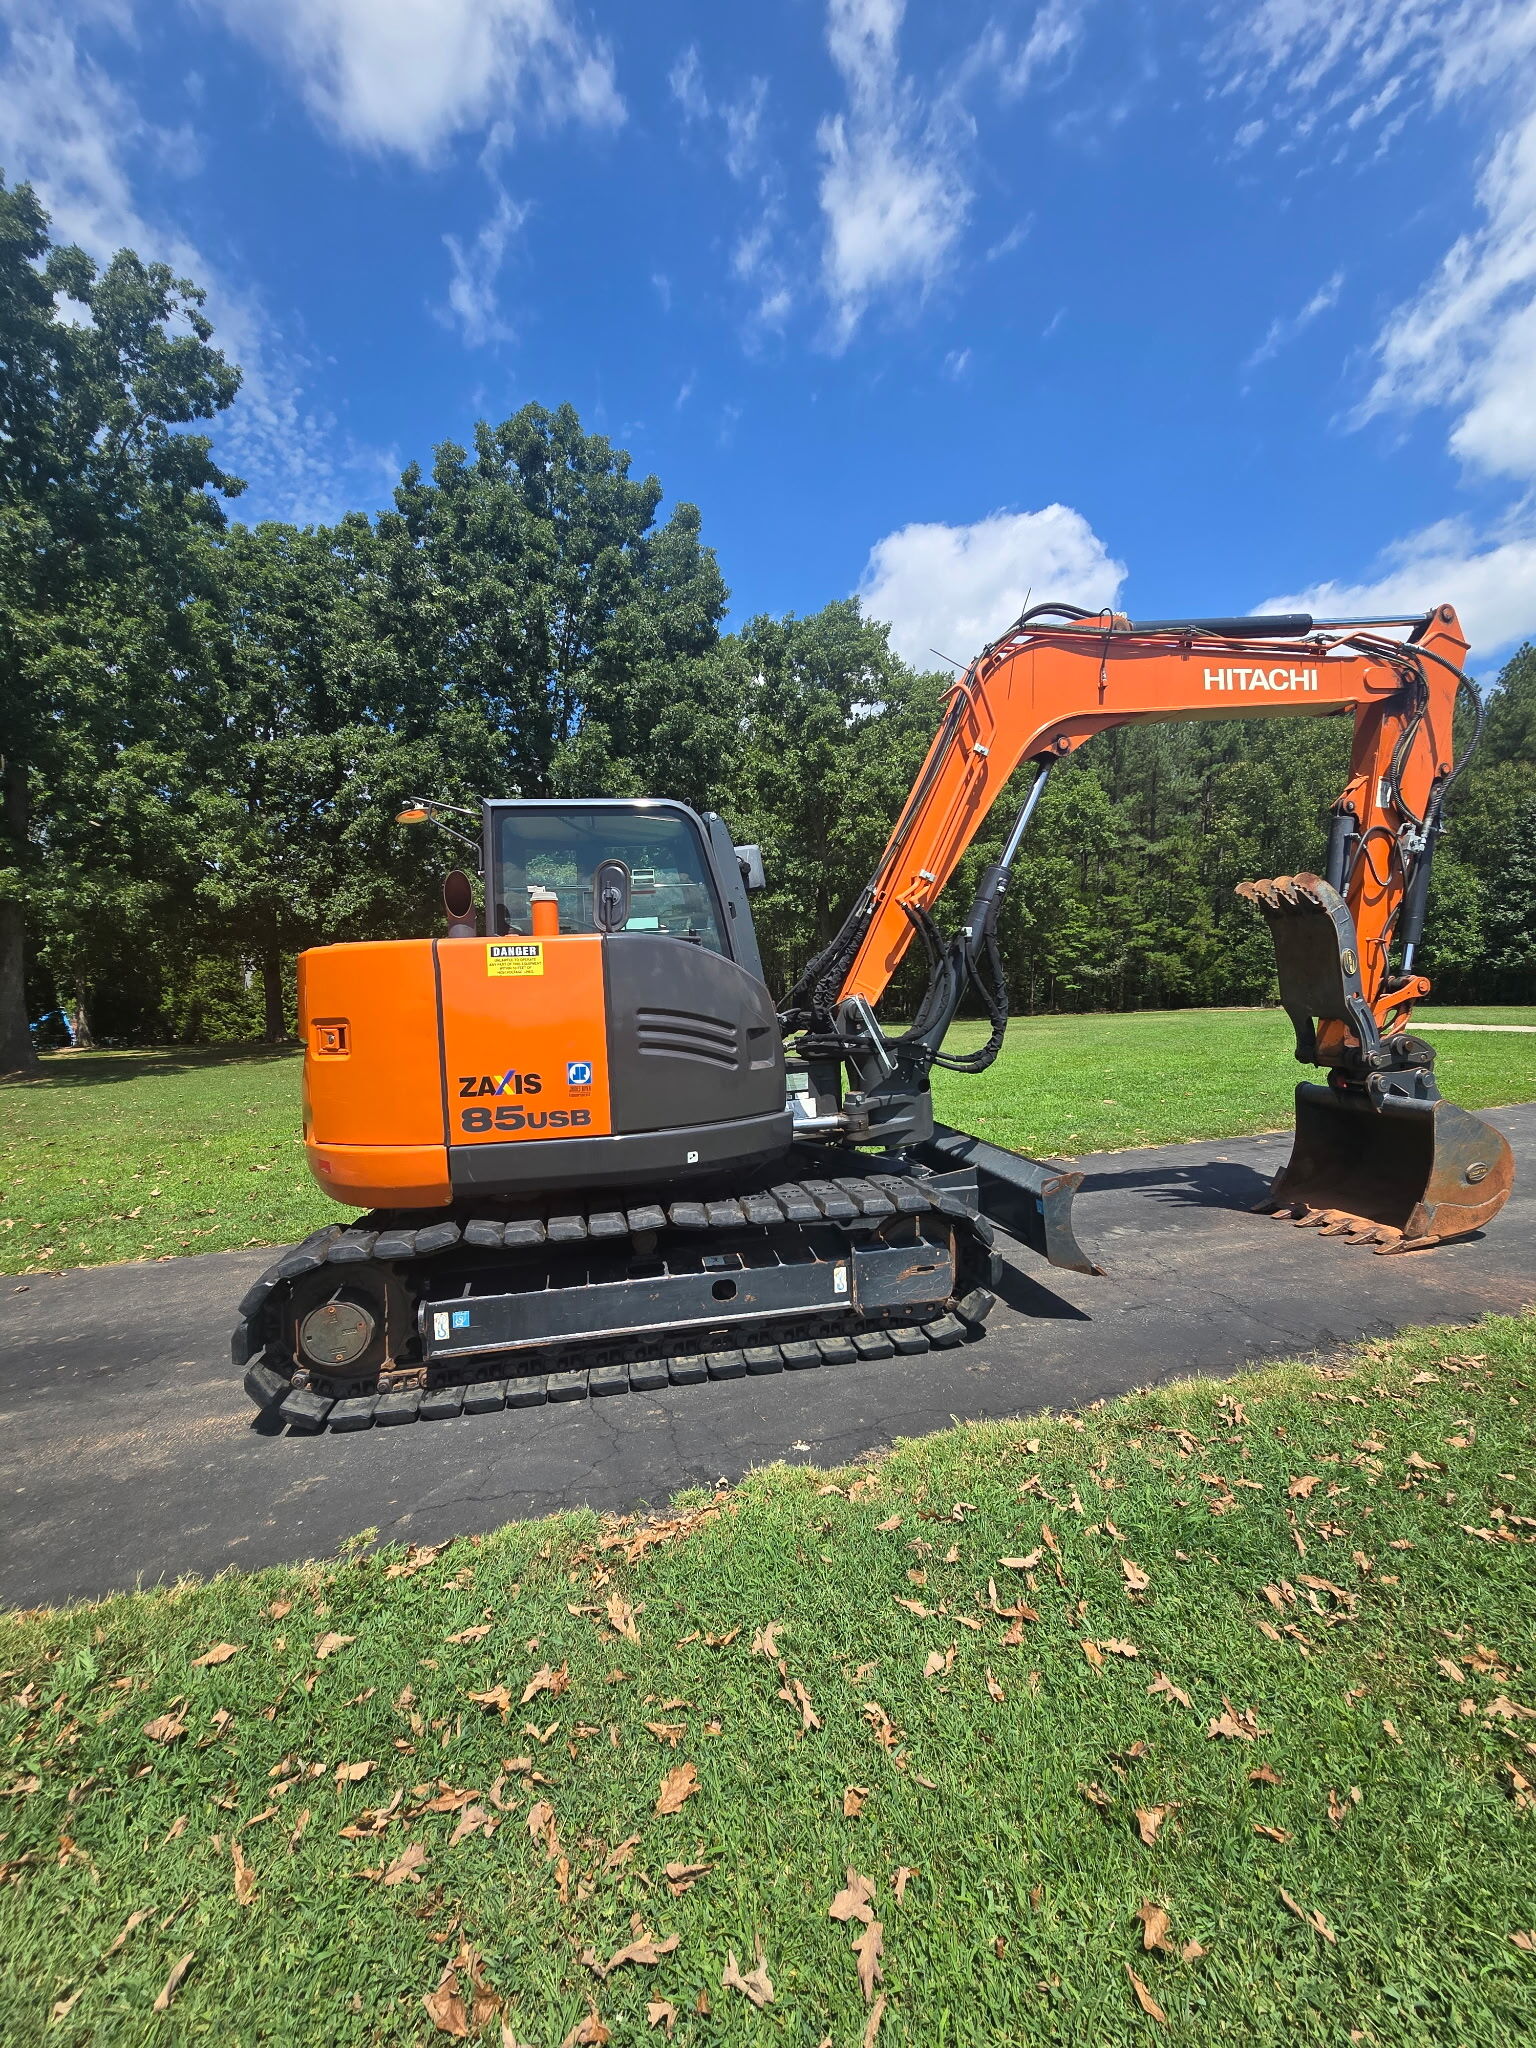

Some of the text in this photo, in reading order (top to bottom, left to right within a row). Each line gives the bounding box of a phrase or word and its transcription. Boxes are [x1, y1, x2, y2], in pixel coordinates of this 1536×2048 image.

[1203, 668, 1318, 691] HITACHI
[493, 946, 537, 957] DANGER
[459, 1069, 542, 1097] ZAXIS
